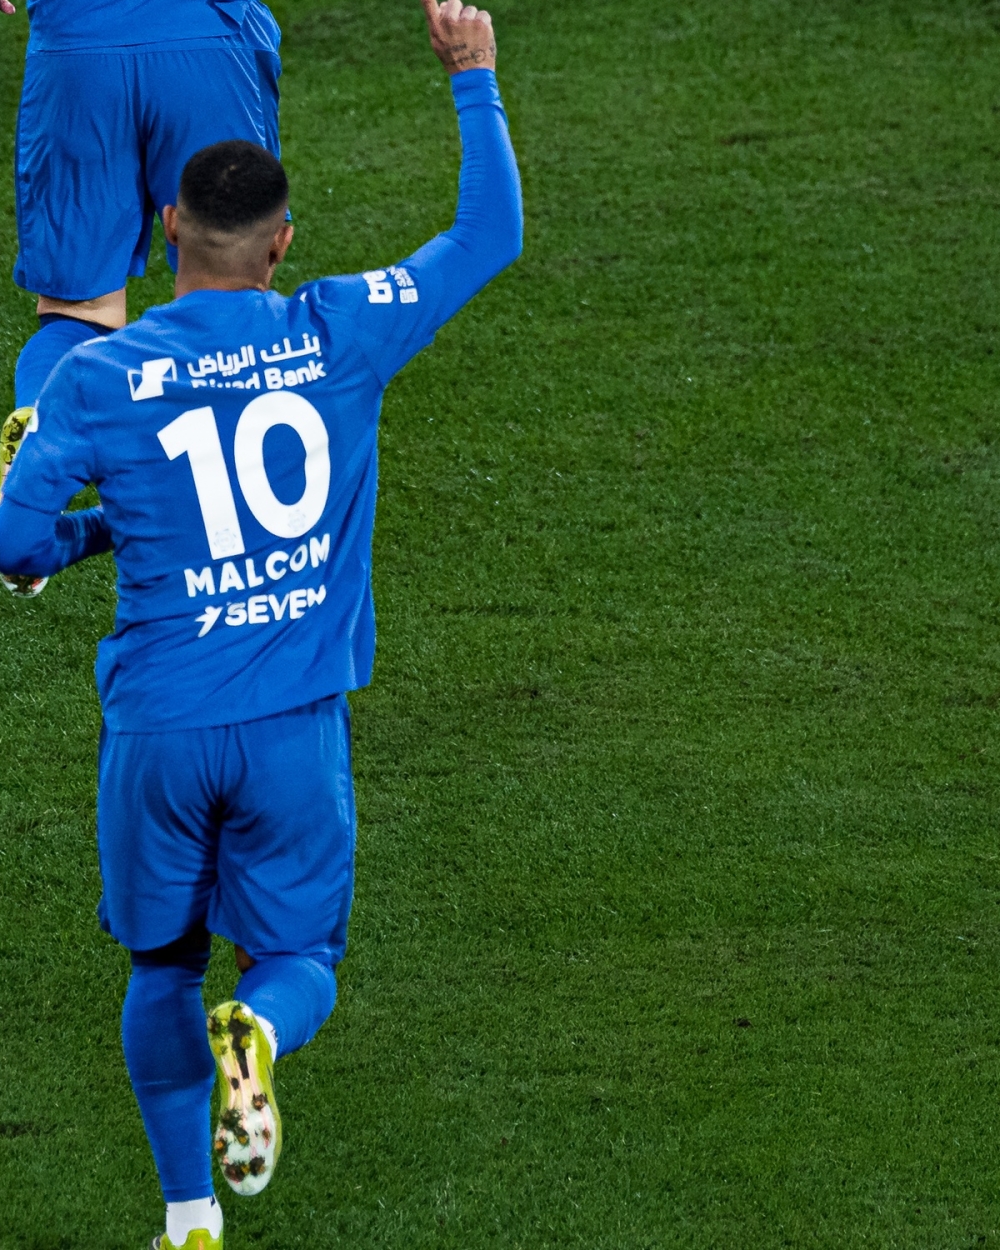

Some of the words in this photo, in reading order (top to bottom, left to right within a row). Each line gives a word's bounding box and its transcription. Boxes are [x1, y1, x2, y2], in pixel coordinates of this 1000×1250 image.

[187, 344, 256, 378] الرياض
[260, 333, 322, 363] بنك
[264, 360, 327, 390] Bank
[157, 391, 331, 561] 10
[184, 533, 331, 598] MALCOM
